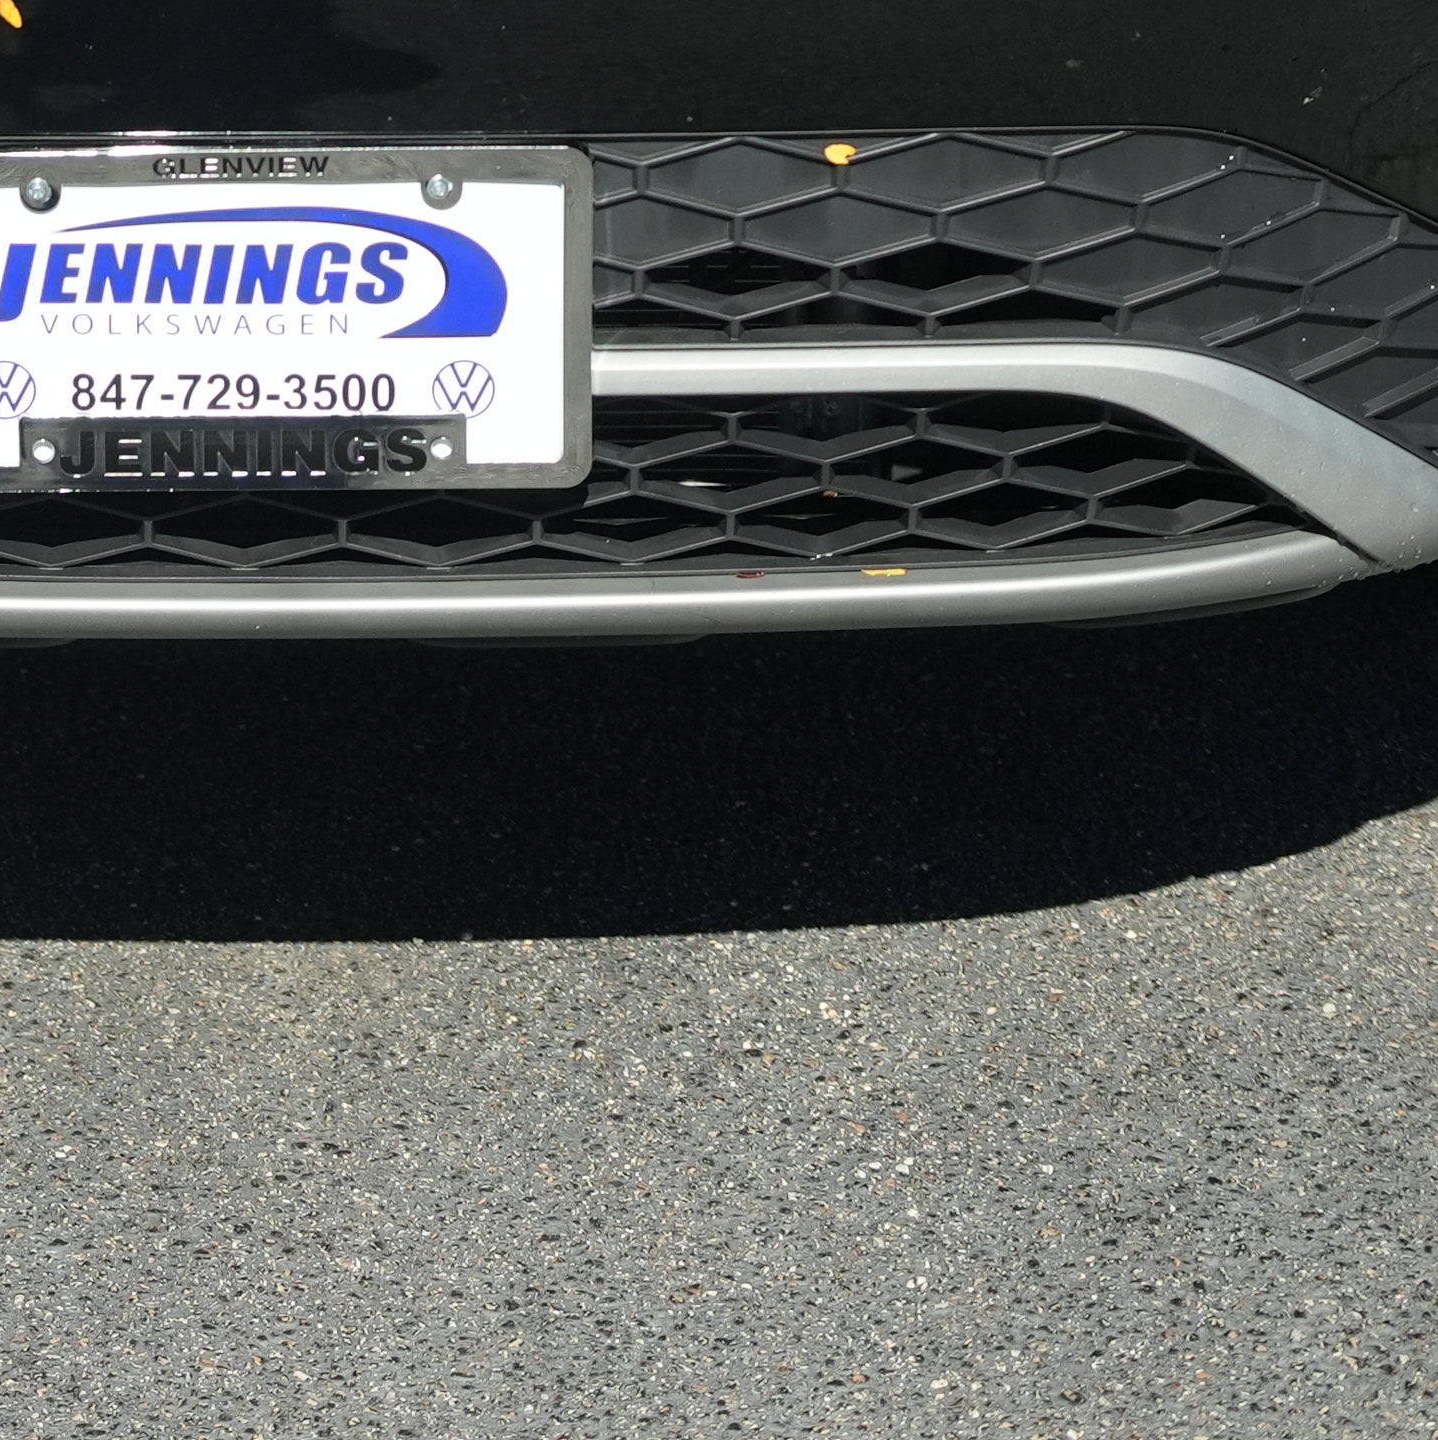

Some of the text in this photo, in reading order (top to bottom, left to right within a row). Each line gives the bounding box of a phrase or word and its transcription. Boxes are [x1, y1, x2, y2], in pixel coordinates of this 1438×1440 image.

[151, 155, 330, 179] GLENVIEW
[40, 313, 349, 336] VOLKSWAGEN
[71, 373, 396, 411] 847-729-3500
[59, 428, 428, 479] JENNINGS
